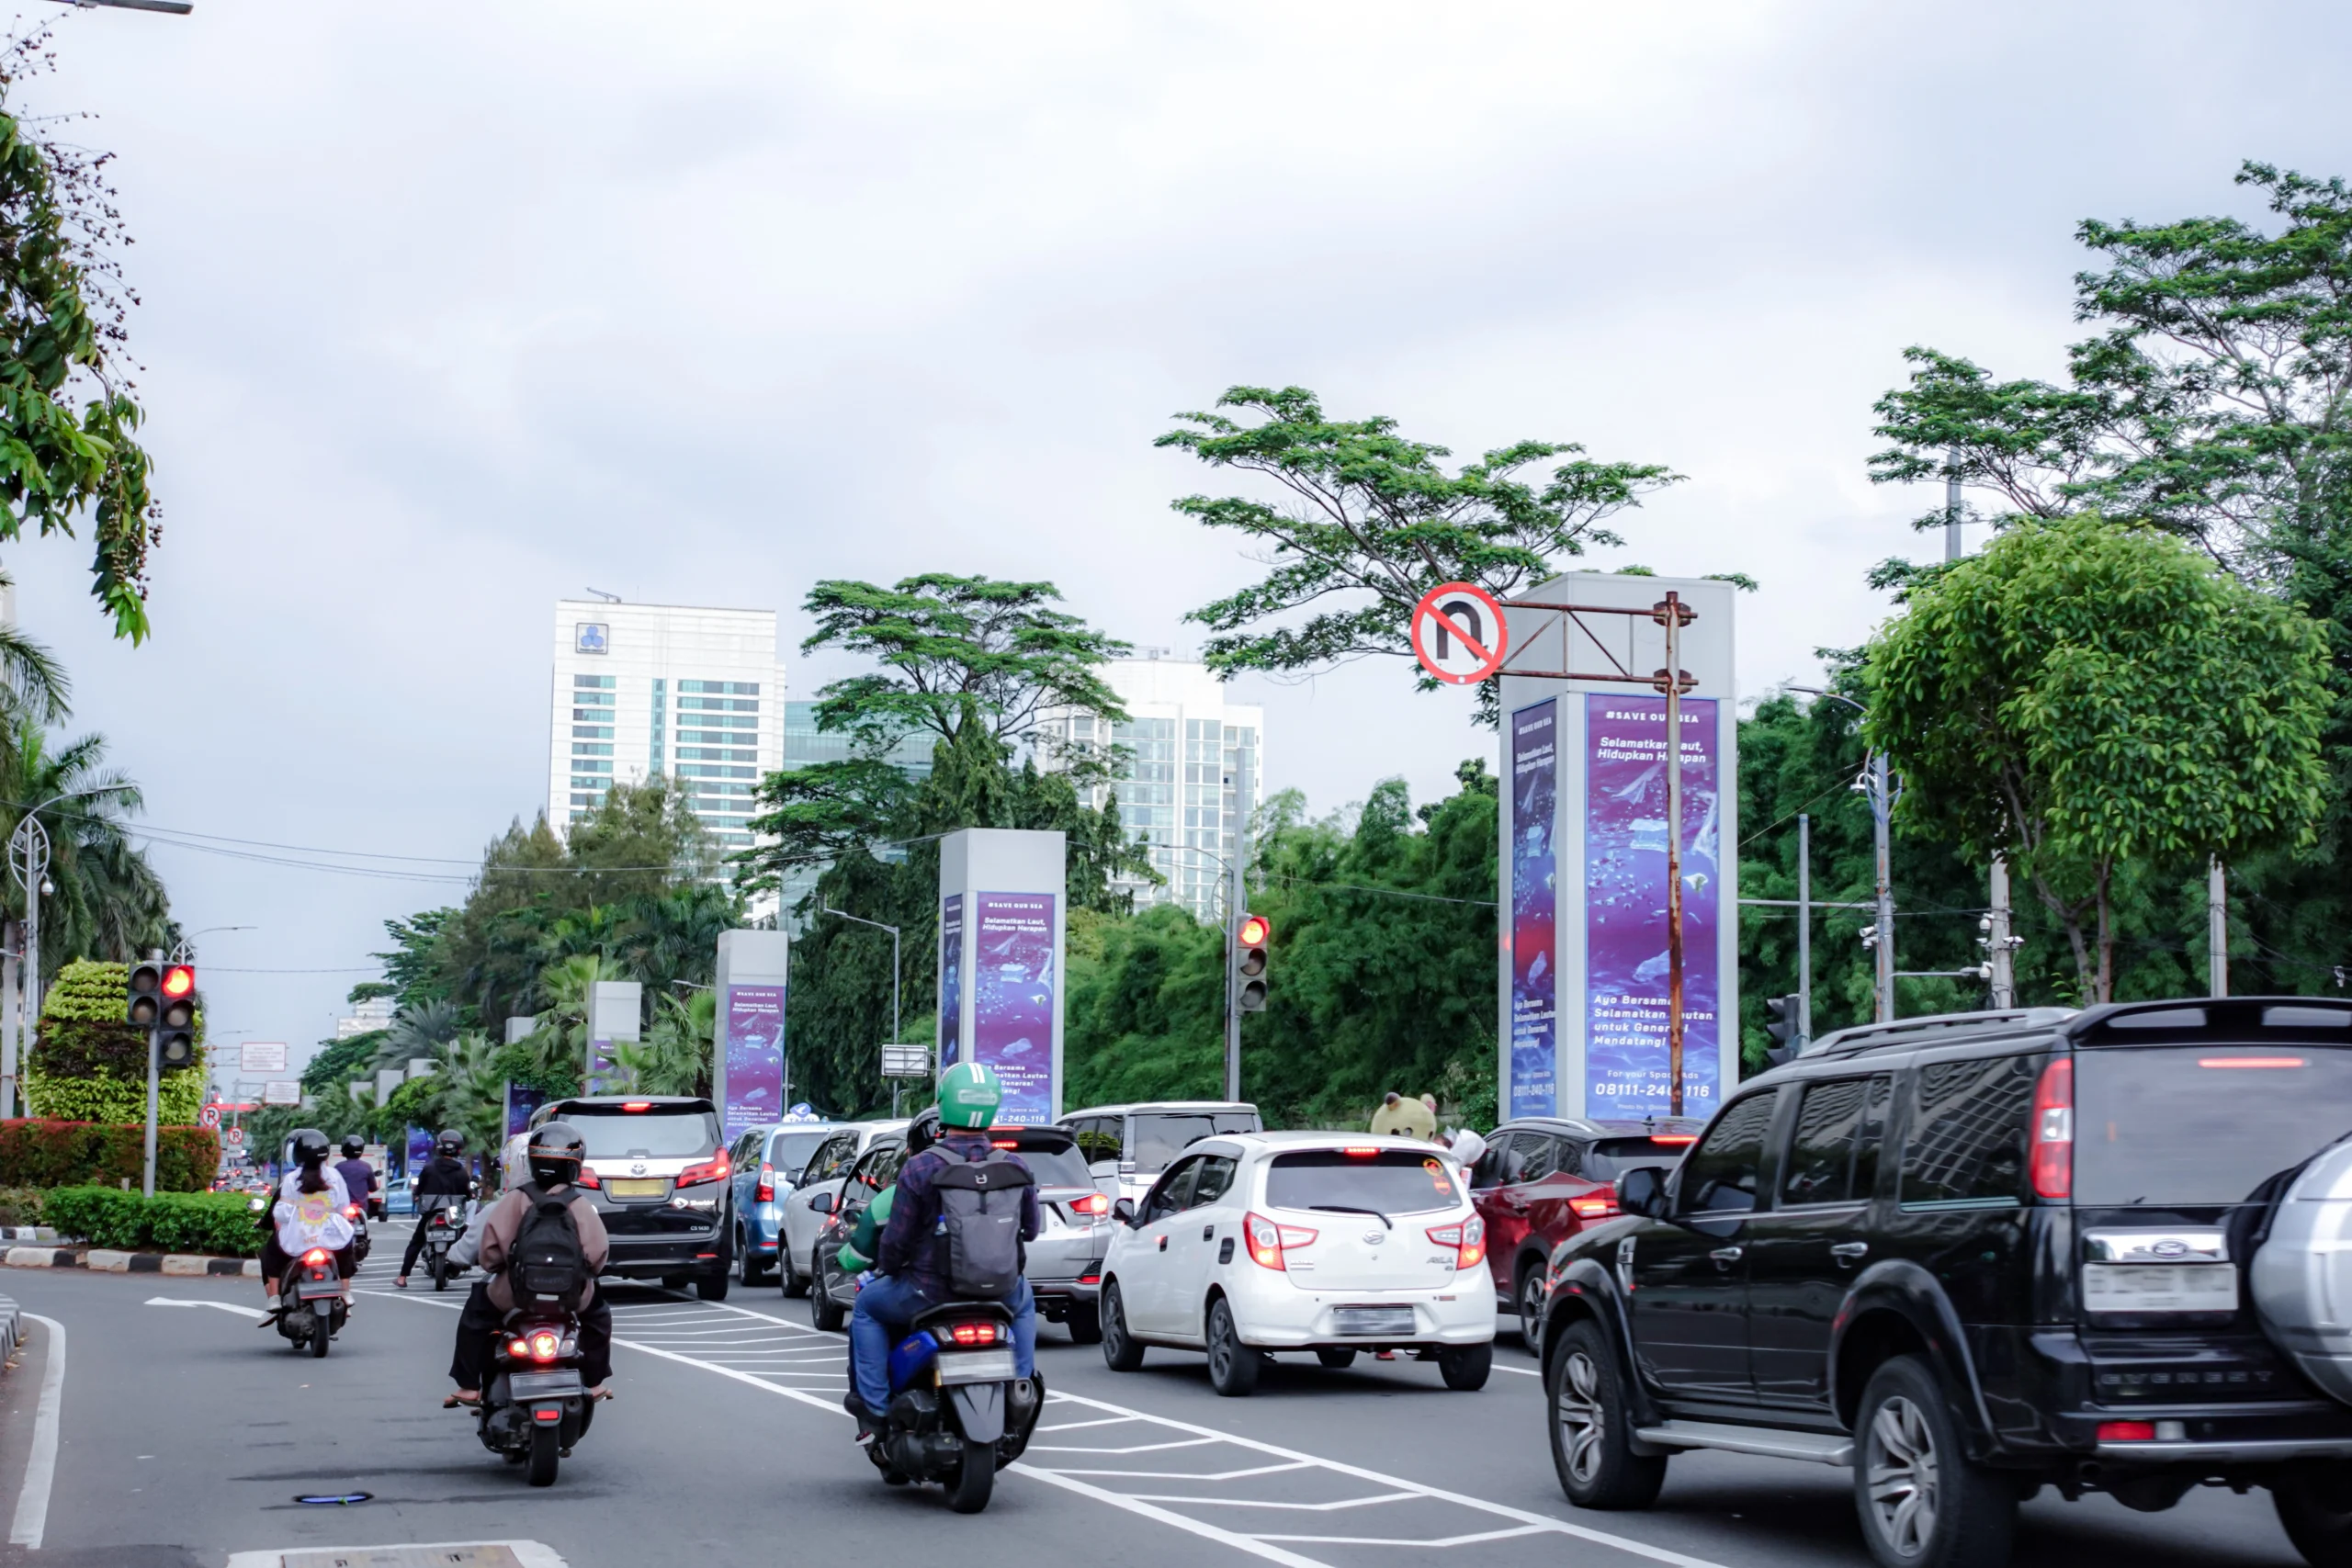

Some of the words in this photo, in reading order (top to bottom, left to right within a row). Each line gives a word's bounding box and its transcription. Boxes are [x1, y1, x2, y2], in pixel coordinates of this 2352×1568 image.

[1606, 711, 1646, 721] #SAVE
[1650, 713, 1666, 722] OU
[1680, 742, 1703, 752] aut,
[1598, 749, 1654, 761] Hidupkan
[984, 917, 1025, 925] Selamatkan
[1594, 996, 1617, 1006] Ayo
[1594, 1009, 1666, 1019] Selamatkan
[1594, 1023, 1629, 1032] untuk
[1634, 1023, 1690, 1032] Generi
[1594, 1036, 1667, 1048] Mendatang!
[1625, 1071, 1646, 1079] your
[1649, 1071, 1672, 1080] Spac
